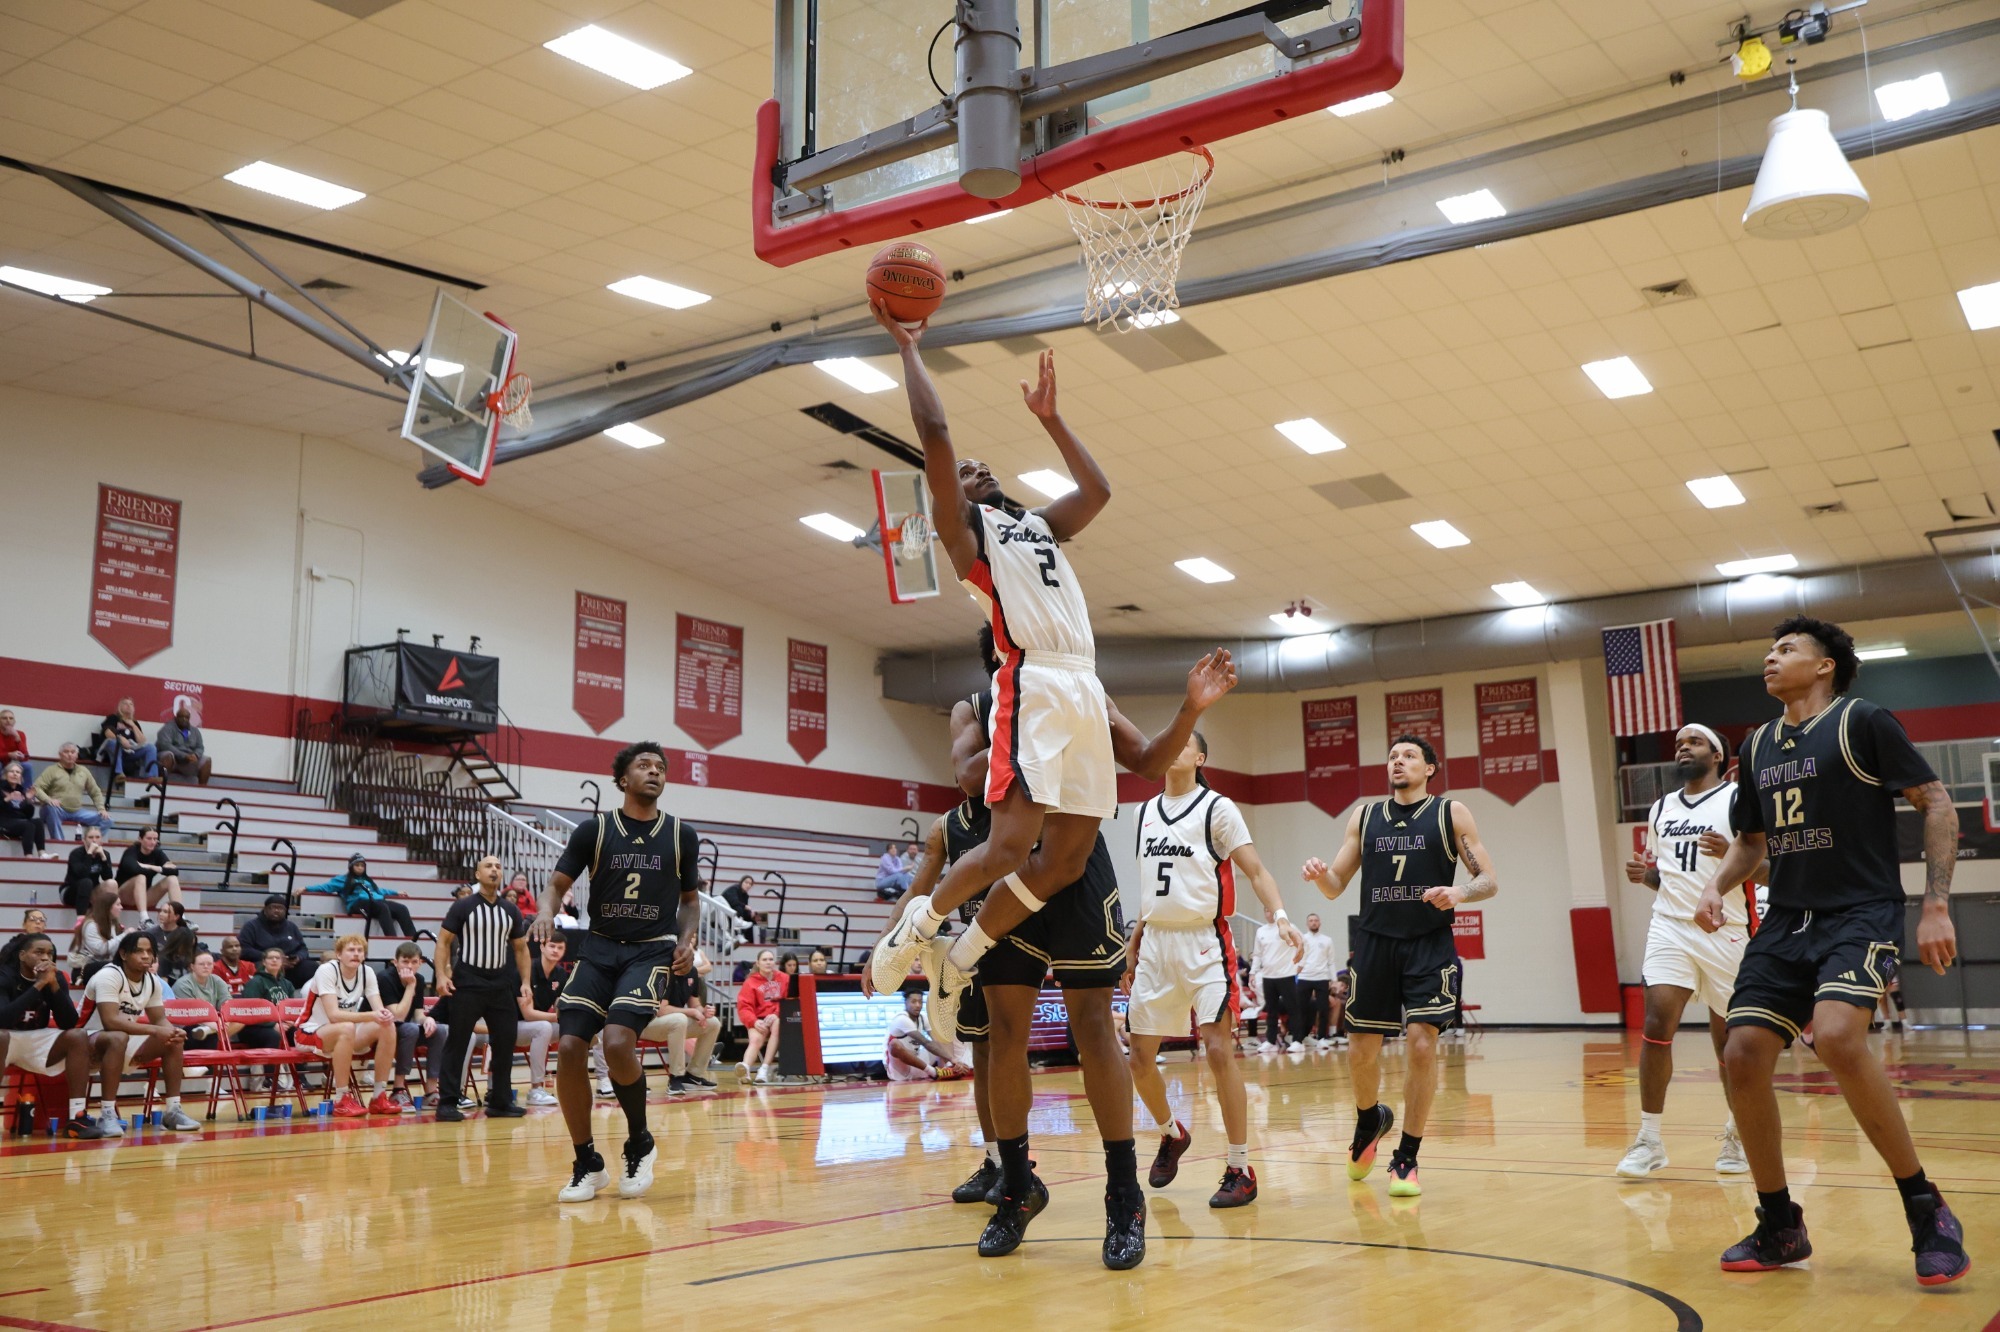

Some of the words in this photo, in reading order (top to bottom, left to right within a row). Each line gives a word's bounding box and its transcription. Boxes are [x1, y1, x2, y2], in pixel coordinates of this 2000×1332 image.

[882, 269, 936, 291] SPALDING
[107, 489, 173, 517] FRIENDS
[105, 504, 172, 526] UNIVERSITY
[1033, 548, 1061, 588] 2
[580, 594, 623, 614] FRIENDS
[692, 619, 729, 637] FRIENDS
[163, 680, 203, 694] SECTION
[1481, 681, 1531, 697] FRIENDS
[425, 694, 473, 709] BSNSPORTS
[685, 751, 708, 762] SECTION
[691, 761, 702, 782] E
[1759, 757, 1817, 789] AVILA
[1772, 787, 1805, 828] 12
[1143, 836, 1195, 858] Falcons
[1375, 834, 1426, 853] AVILA
[610, 853, 661, 870] AVILA
[1675, 840, 1698, 872] 41
[1392, 854, 1407, 882] 7
[623, 872, 642, 900] 2
[1155, 862, 1174, 897] 5
[600, 903, 660, 920] EAGLES
[22, 1010, 36, 1023] F
